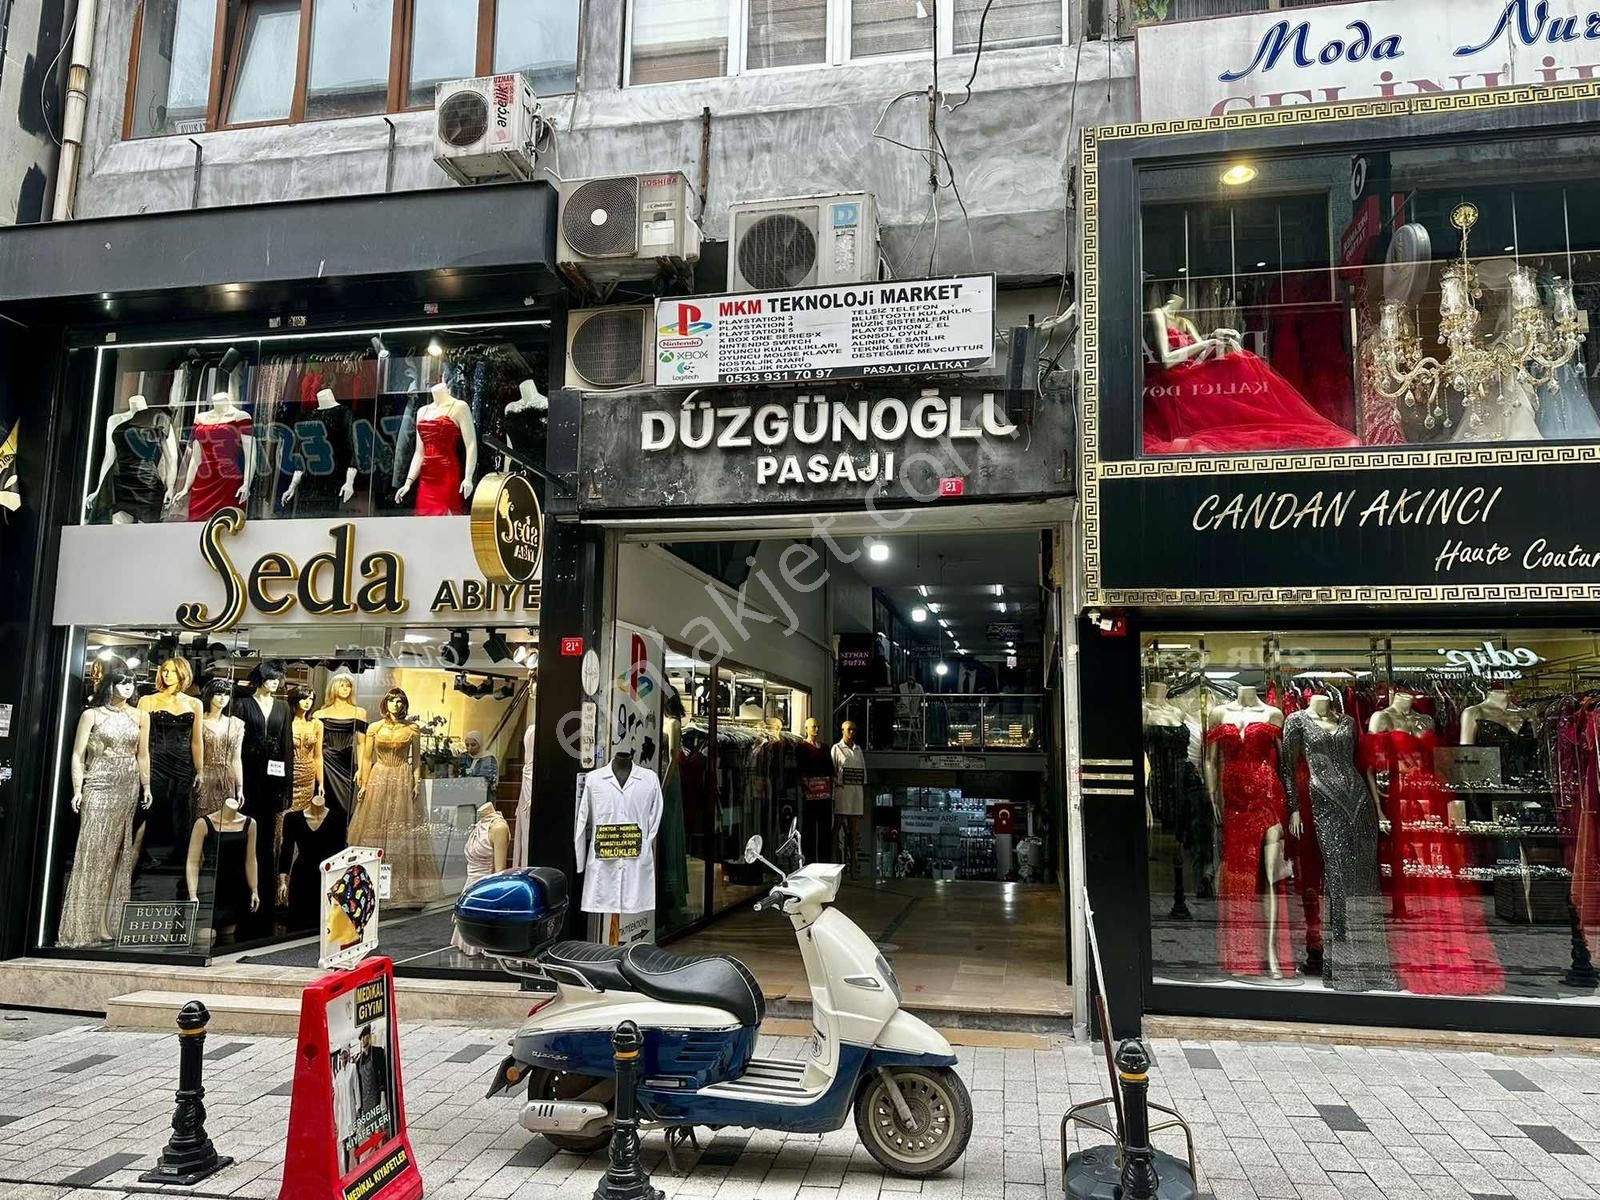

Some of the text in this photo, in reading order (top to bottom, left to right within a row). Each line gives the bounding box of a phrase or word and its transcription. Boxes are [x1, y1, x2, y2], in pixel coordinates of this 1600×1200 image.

[1217, 19, 1405, 83] Moda
[719, 299, 762, 316] MKM
[880, 284, 962, 304] MARKET
[890, 304, 938, 312] TELEFON
[719, 315, 785, 325] PLAYSTATION
[851, 307, 972, 322] BLUETOOTH KULAKLIK
[719, 321, 785, 331] PLAYSTATION
[851, 325, 921, 334] PLAYSTATION
[719, 328, 785, 338] PLAYSTATION
[851, 329, 928, 341] KONSOL OYUN
[905, 335, 945, 343] SATILIR
[719, 341, 769, 349] NINTENDO
[917, 344, 984, 354] MEVCUTTUR
[677, 350, 708, 360] XBOX
[719, 347, 760, 356] OYUNCU
[719, 348, 842, 362] OYUNCU MOUSE KLAVYE
[776, 362, 812, 370] RADYO
[863, 365, 901, 375] PASAJ
[922, 360, 970, 371] ALTKAT
[725, 369, 833, 383] 0533 931 70 97
[756, 451, 895, 485] PASAJI
[945, 481, 956, 491] 21
[1192, 486, 1503, 532] CANDAN AKINCI
[501, 502, 539, 548] Seda
[1434, 539, 1511, 571] Haute
[176, 506, 409, 632] Seda
[430, 579, 541, 612] ABIYE
[599, 846, 638, 857] ÖNLÜKLER
[136, 905, 182, 917] BÜYÜK
[129, 921, 185, 930] BEDEN
[123, 934, 187, 943] BULUNUR
[373, 1149, 407, 1184] KIYAFETLER
